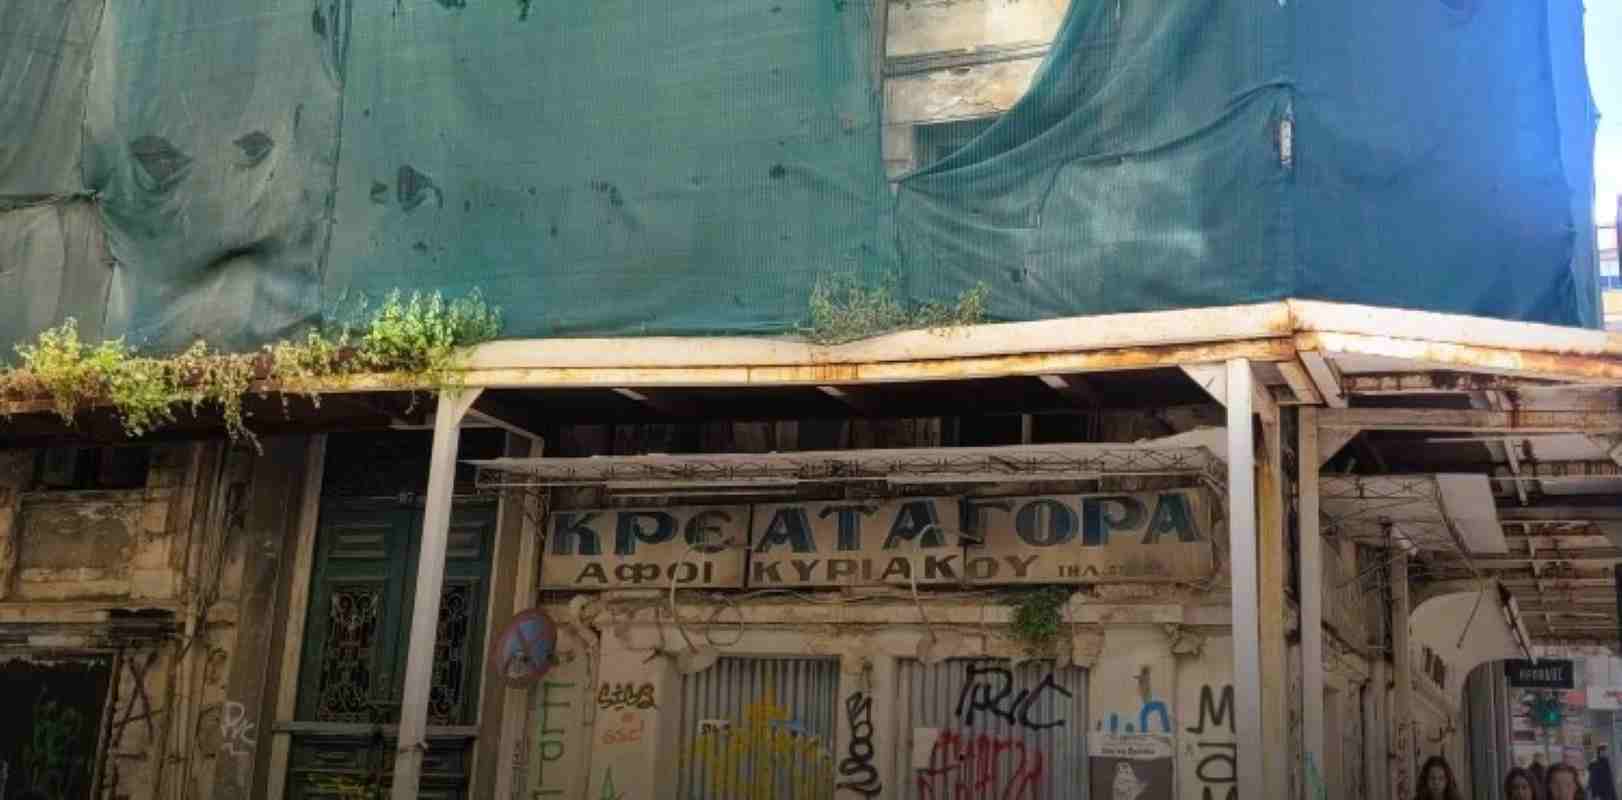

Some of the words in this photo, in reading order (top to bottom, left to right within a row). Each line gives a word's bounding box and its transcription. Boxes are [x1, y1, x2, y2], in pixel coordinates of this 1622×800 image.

[551, 493, 1202, 555] ΚΡΕΑΤΑΓΟΡΑ
[575, 561, 712, 584] ΑΦΟΙ
[753, 555, 1040, 582] ΚΥΡΙΑΚΟΥ
